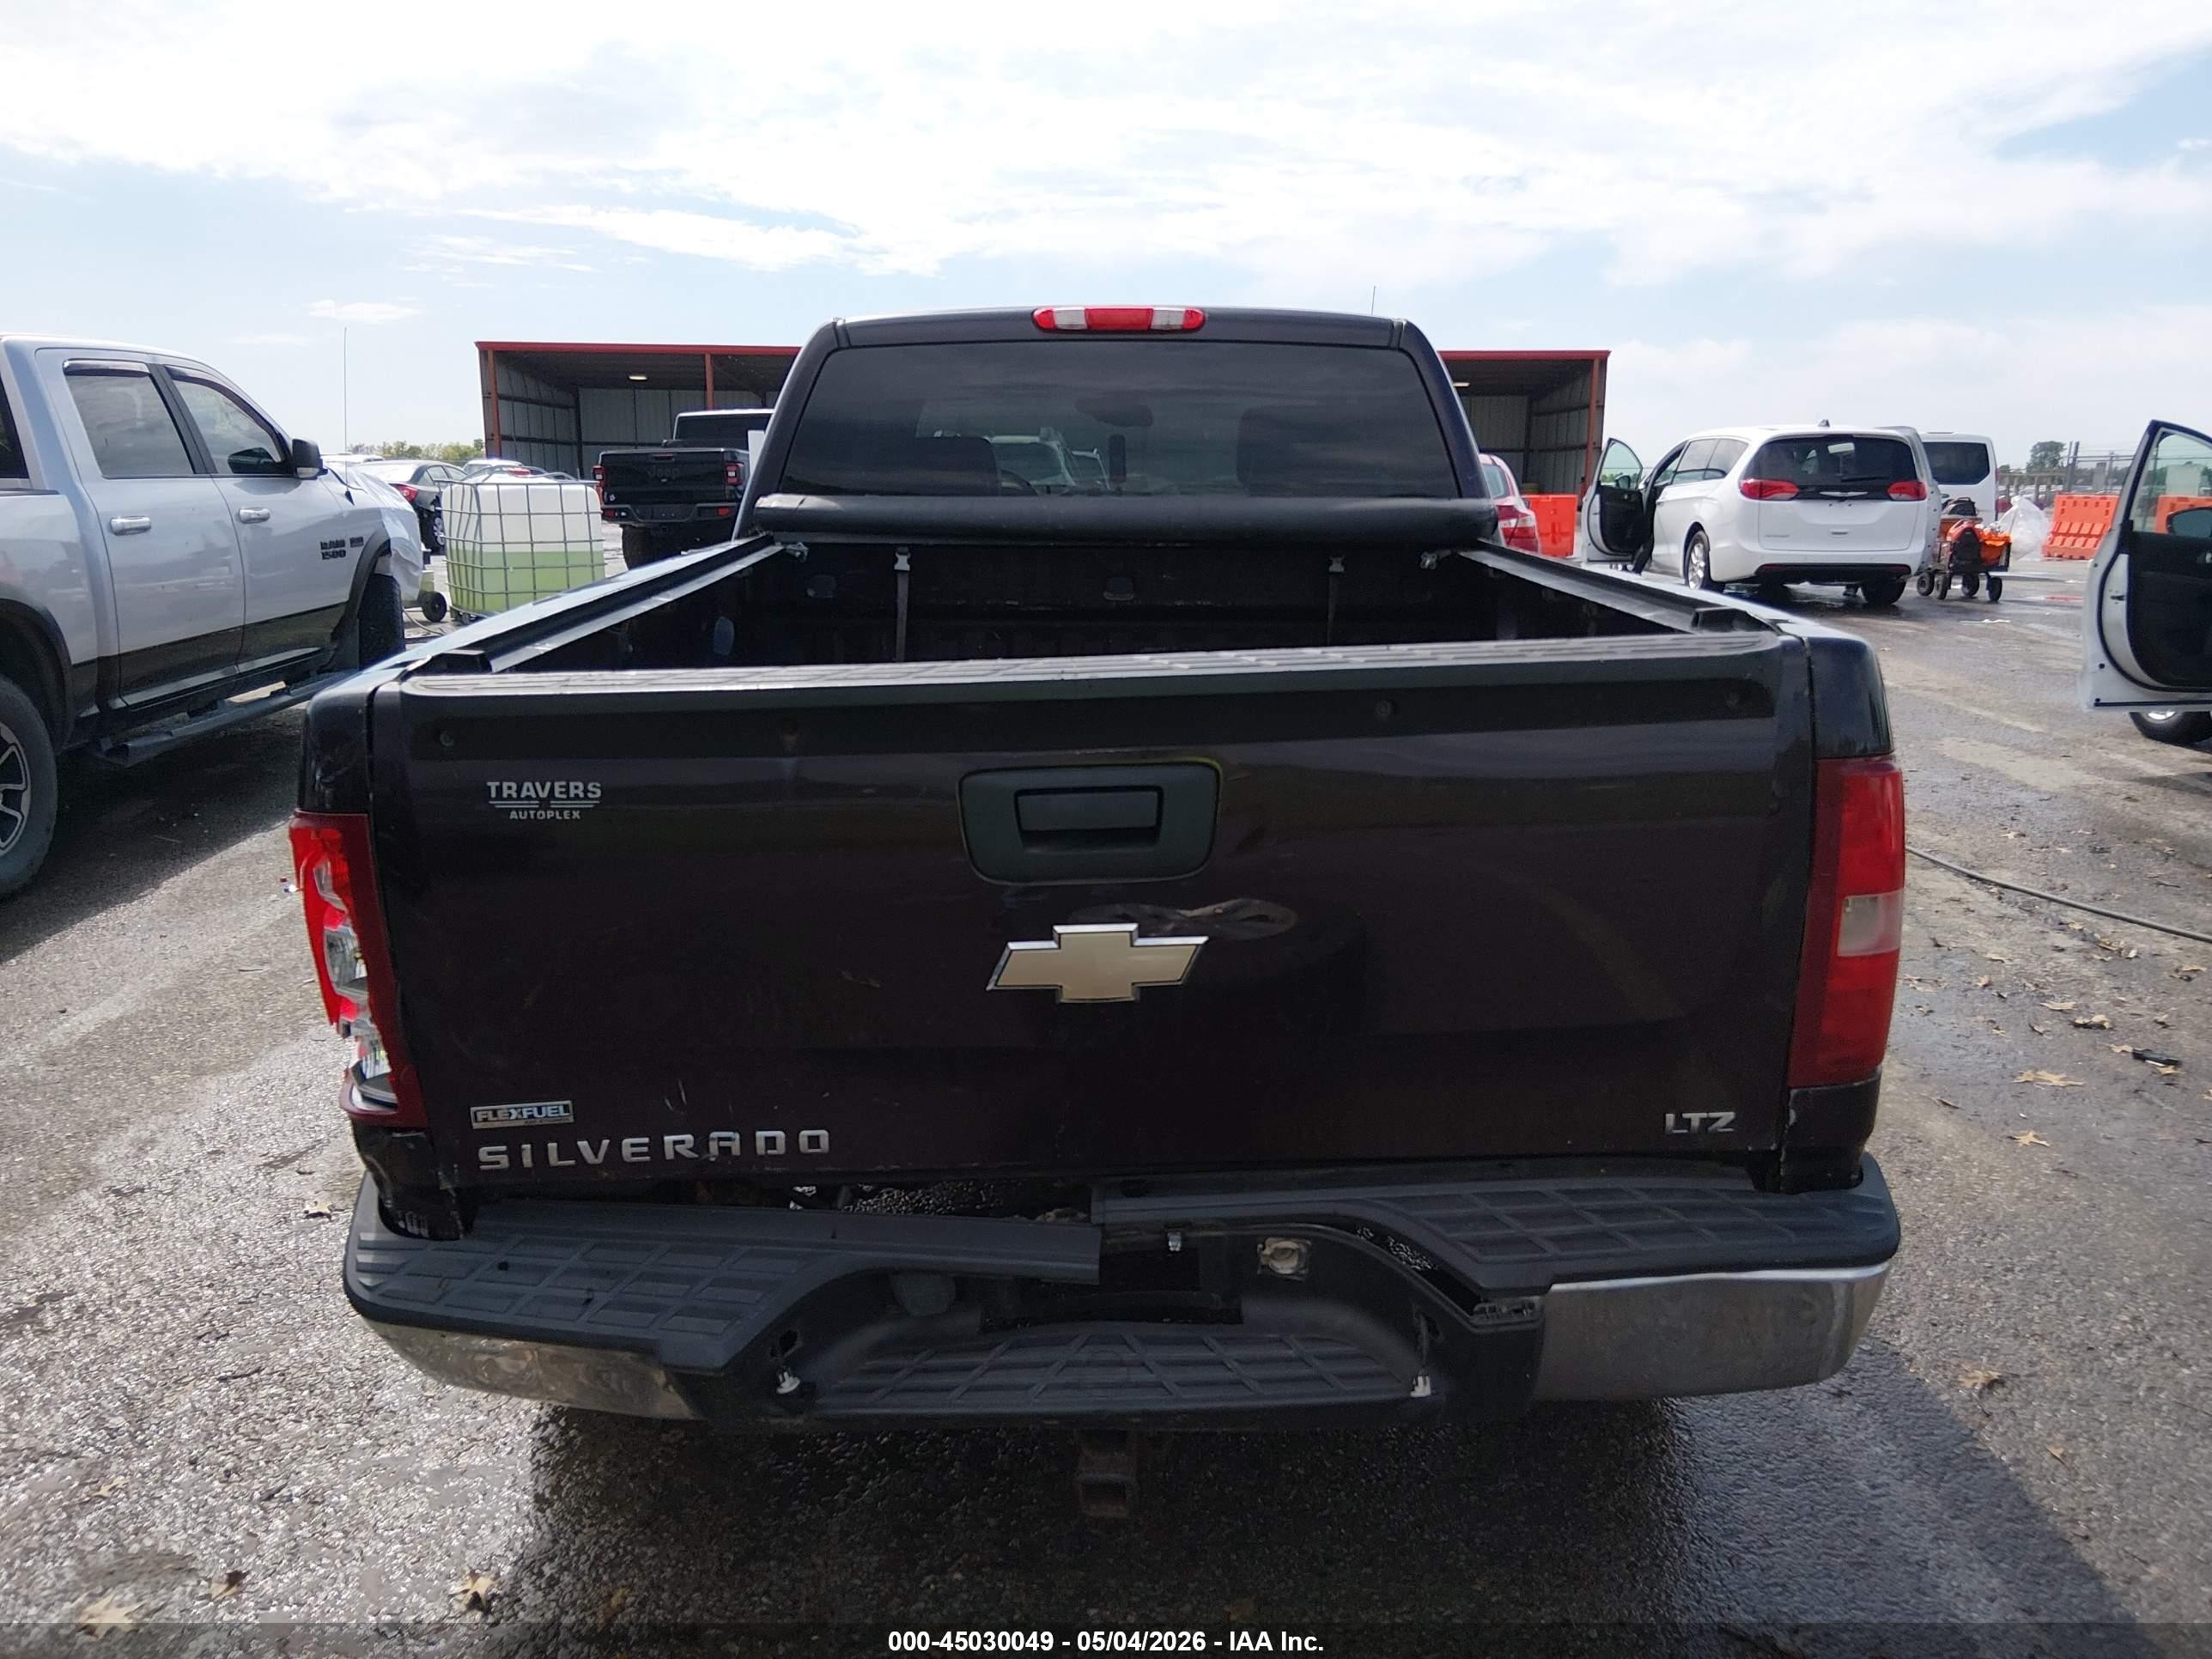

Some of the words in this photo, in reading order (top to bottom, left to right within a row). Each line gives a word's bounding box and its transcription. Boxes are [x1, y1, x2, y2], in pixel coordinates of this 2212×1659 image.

[486, 781, 602, 799] TRAVERS
[509, 810, 580, 819] AUTOPLEX
[475, 1104, 570, 1121] FLEXFUEL
[1665, 1111, 1735, 1133] LTZ
[477, 1128, 830, 1170] SILVERADO
